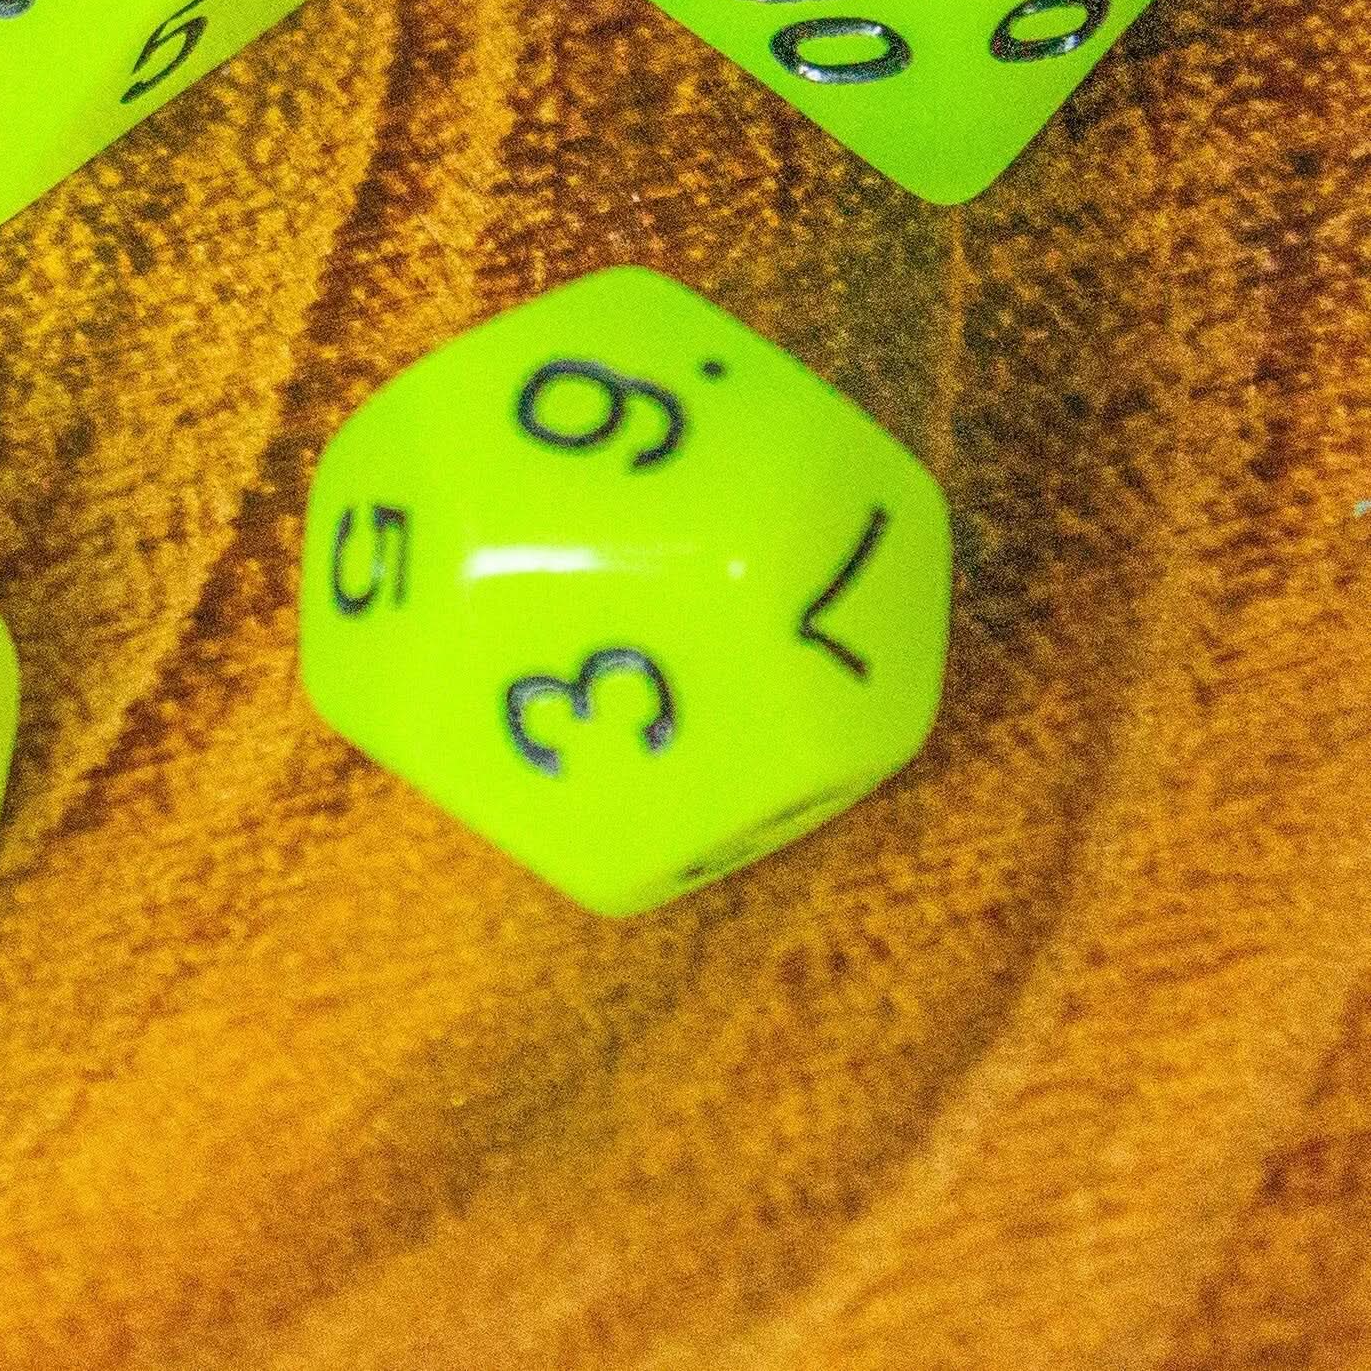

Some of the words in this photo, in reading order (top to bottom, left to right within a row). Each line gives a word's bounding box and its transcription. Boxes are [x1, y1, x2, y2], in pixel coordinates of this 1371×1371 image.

[331, 502, 410, 619] 5
[795, 504, 893, 683] 7
[503, 645, 680, 774] 3
